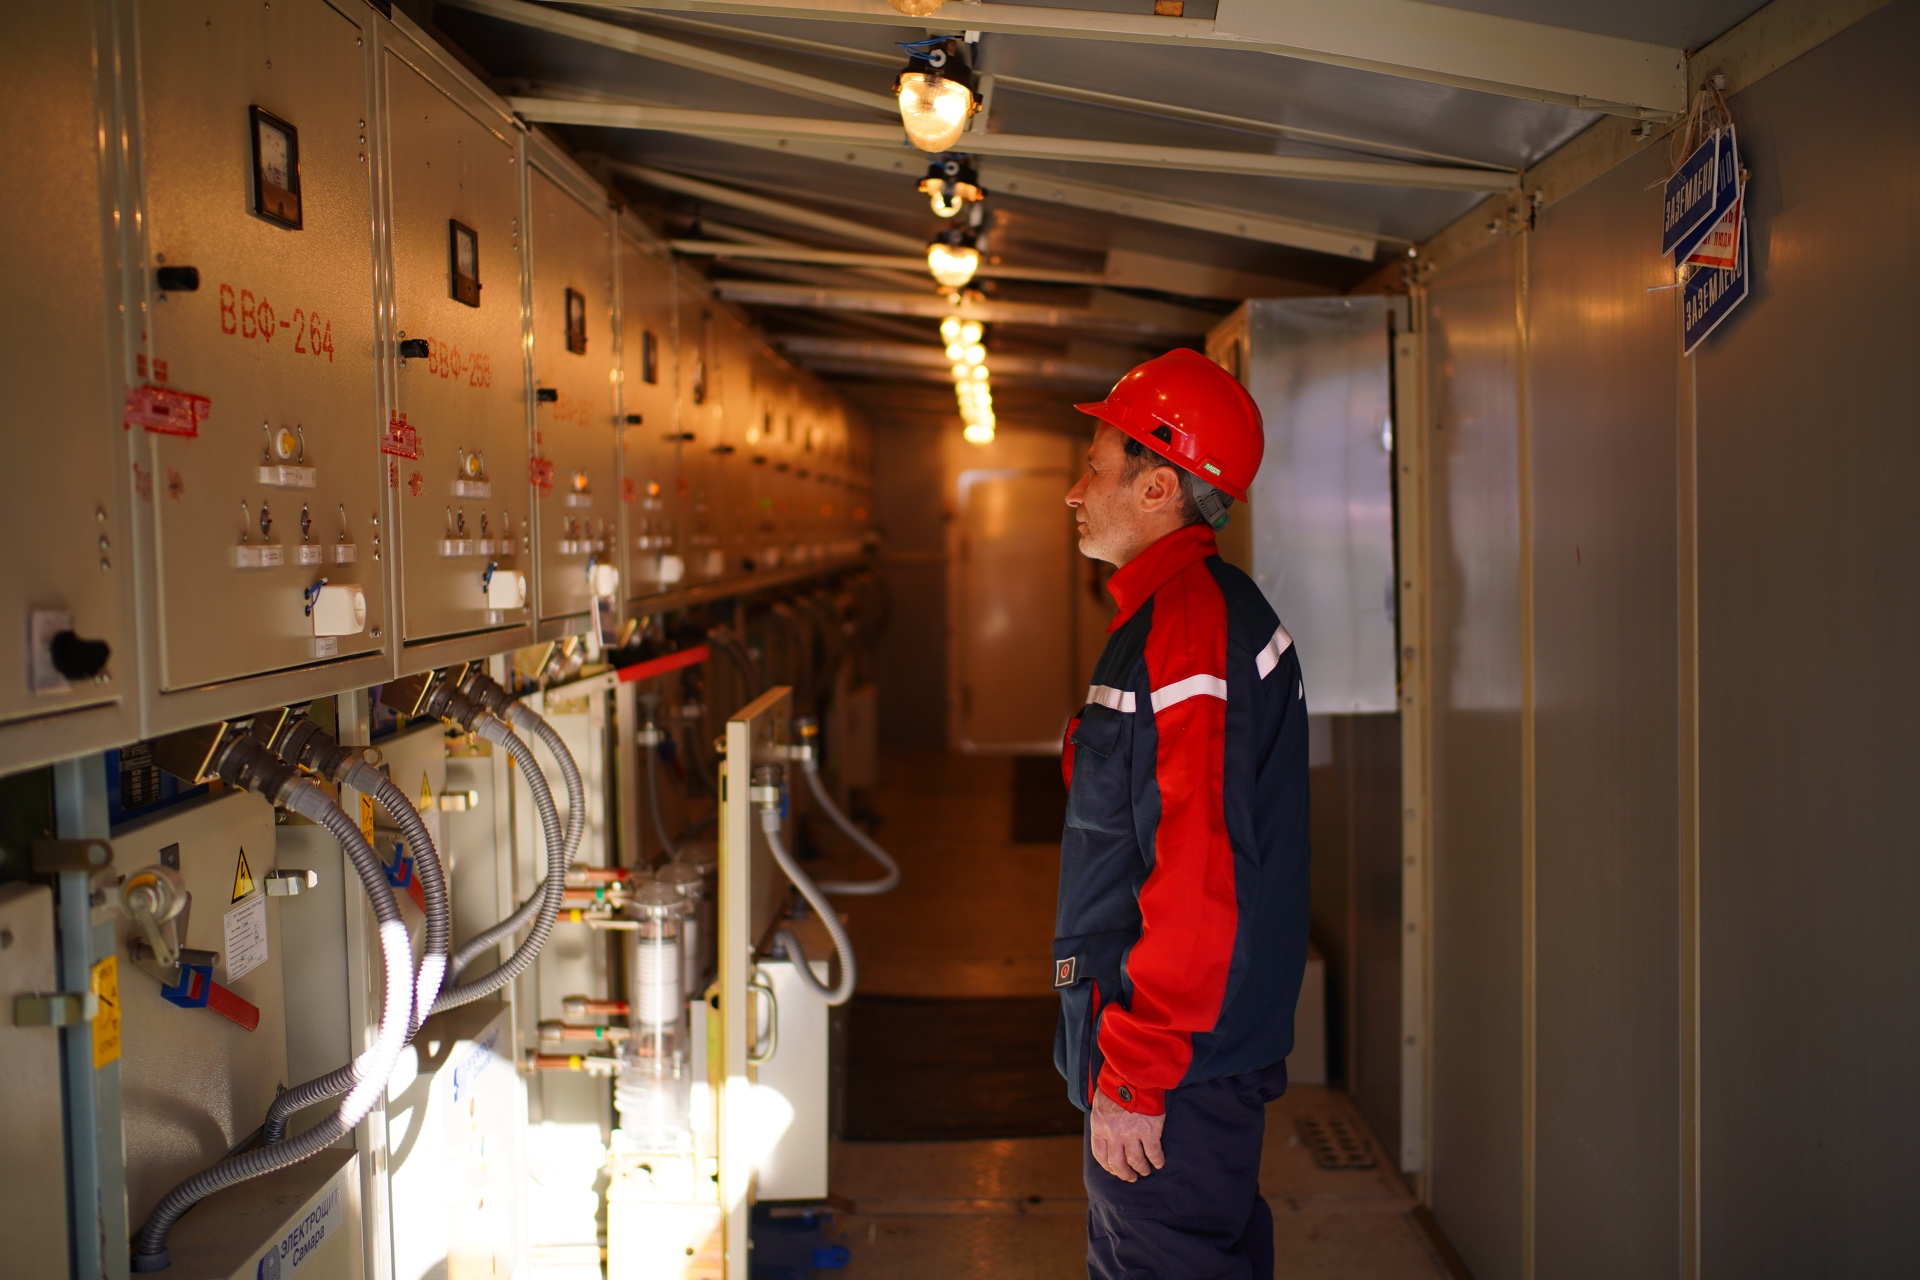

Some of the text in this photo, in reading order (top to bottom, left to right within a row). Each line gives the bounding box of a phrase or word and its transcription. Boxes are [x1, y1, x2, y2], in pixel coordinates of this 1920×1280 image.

[1665, 156, 1714, 233] ЗАЗЕМЛЕНО
[220, 283, 334, 363] ВВФ-264
[281, 1187, 339, 1259] ЭЛЕКТРОЩИТ
[293, 1225, 325, 1267] Самара
